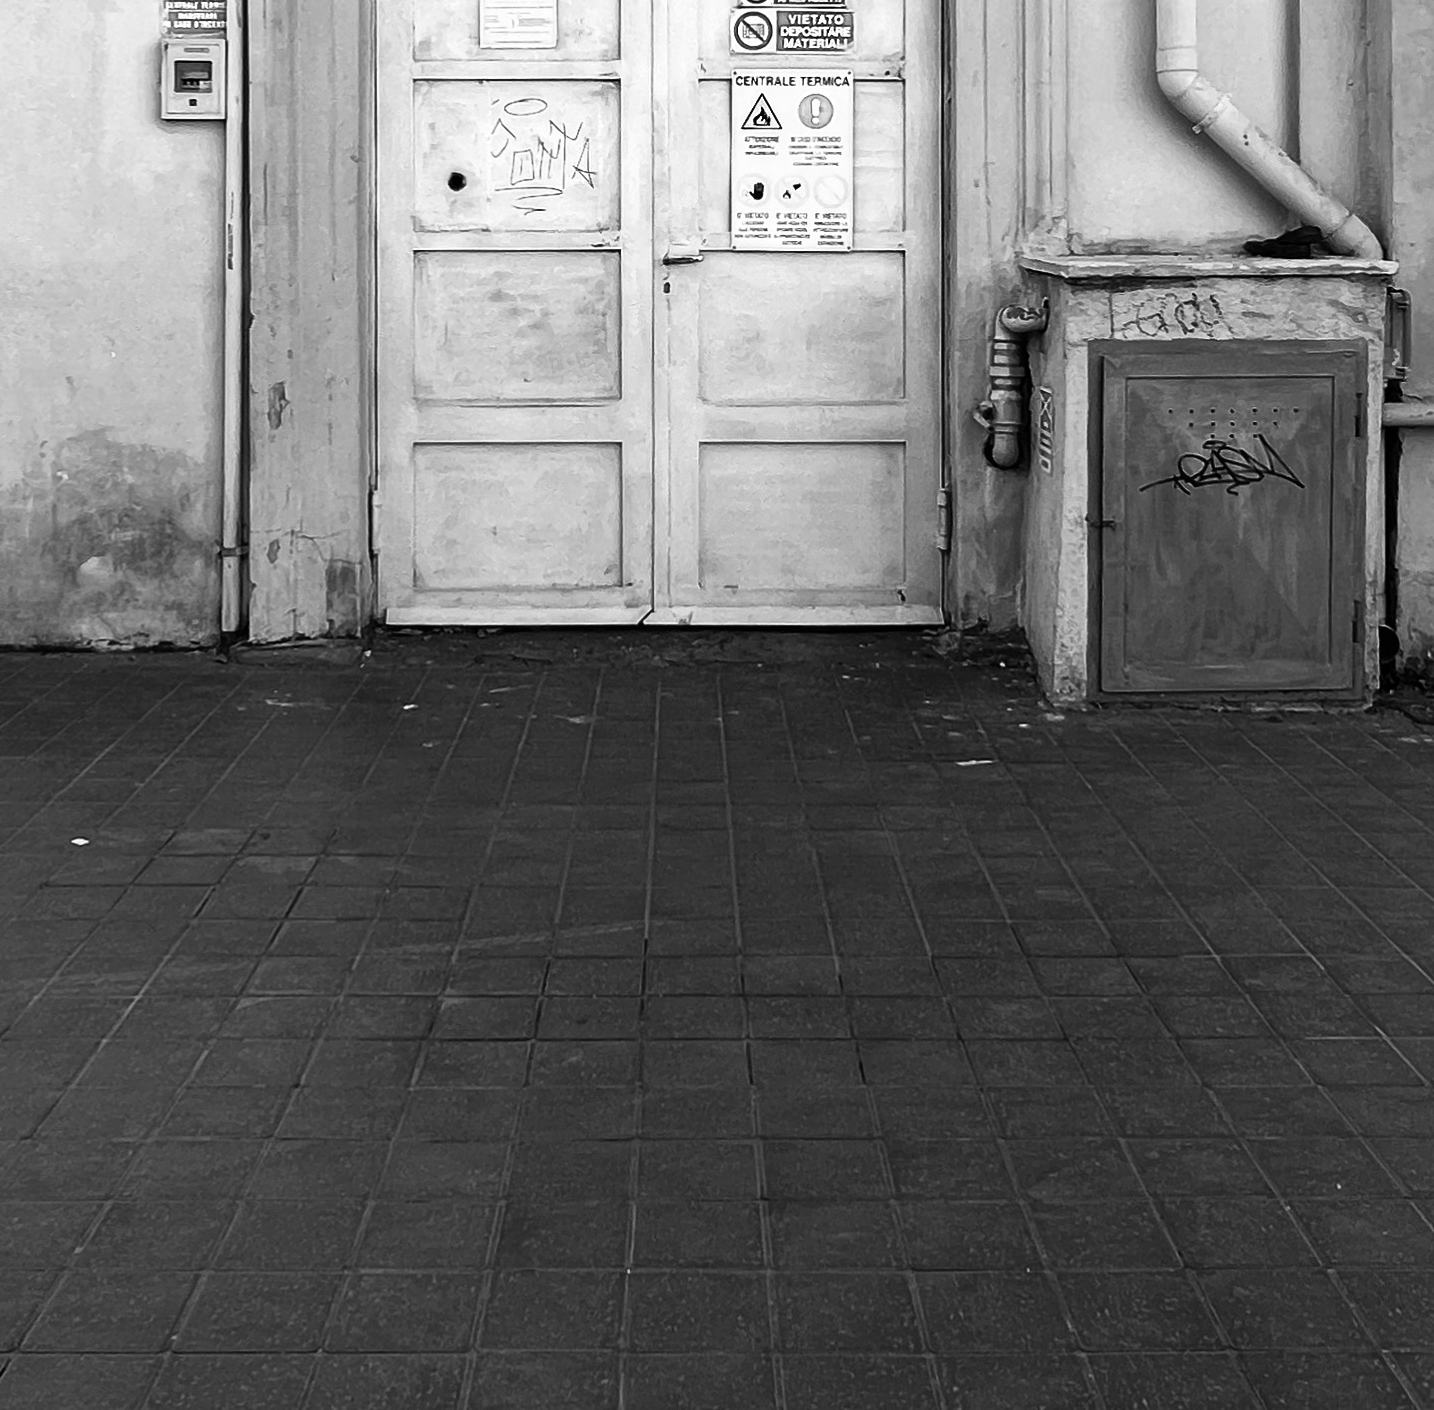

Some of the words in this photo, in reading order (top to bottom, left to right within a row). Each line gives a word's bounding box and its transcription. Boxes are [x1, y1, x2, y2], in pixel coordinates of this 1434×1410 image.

[788, 14, 844, 25] VIETATO
[780, 26, 851, 37] DEPOSITARE
[783, 38, 848, 49] MATERIALI
[735, 75, 796, 86] CENTRALE
[800, 76, 850, 87] TERMICA
